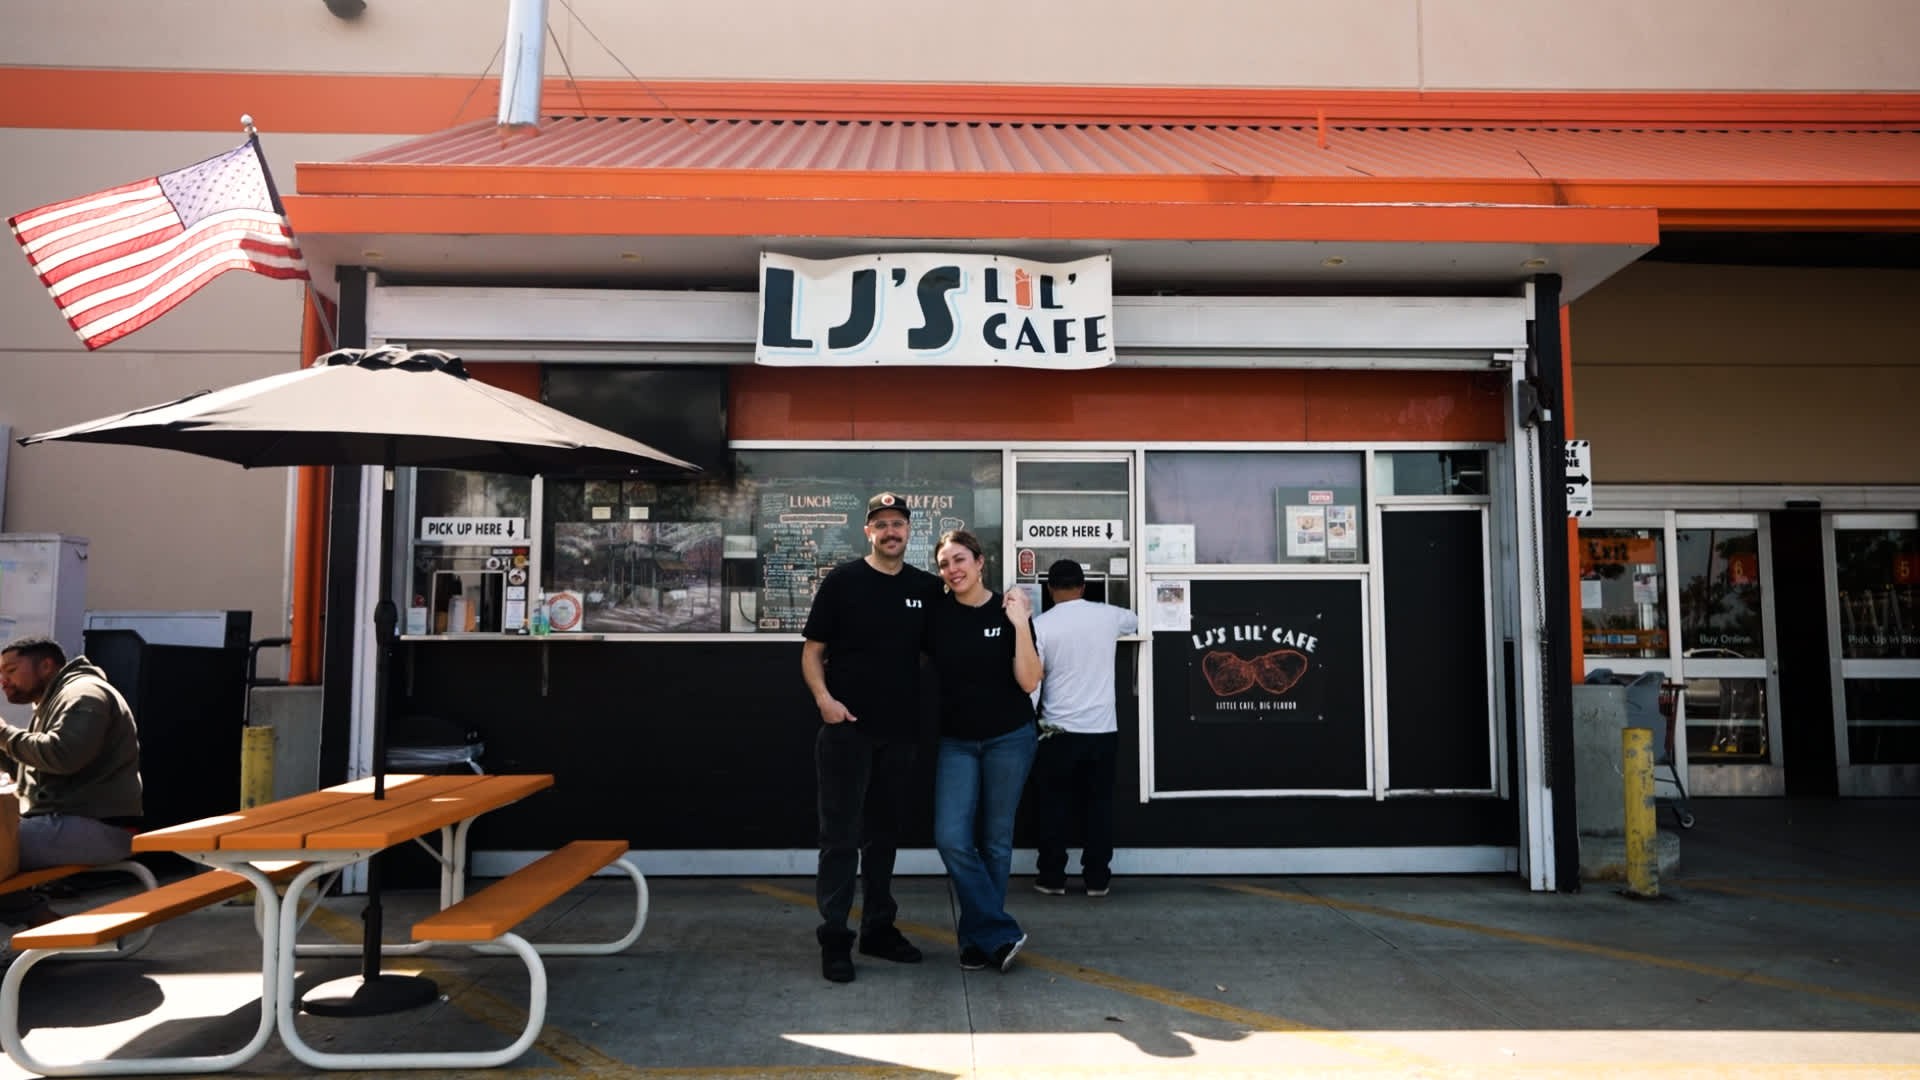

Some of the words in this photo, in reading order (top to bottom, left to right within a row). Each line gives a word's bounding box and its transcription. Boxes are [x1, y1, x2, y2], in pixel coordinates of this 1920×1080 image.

[762, 265, 961, 350] LJ'S
[983, 313, 1107, 353] CAFE
[789, 495, 831, 508] LUNCH
[428, 522, 453, 535] PICK
[457, 522, 472, 535] UP
[475, 523, 502, 535] HERE
[1029, 525, 1068, 537] ORDER
[1072, 525, 1101, 537] HERE
[1192, 627, 1226, 650] LJ'S
[1233, 625, 1267, 641] LIL'
[1271, 627, 1318, 653] CAFE
[1700, 634, 1718, 646] Buy
[1215, 701, 1237, 710] LITTLE
[1260, 701, 1271, 710] BIG
[1273, 701, 1297, 710] FLAVOR
